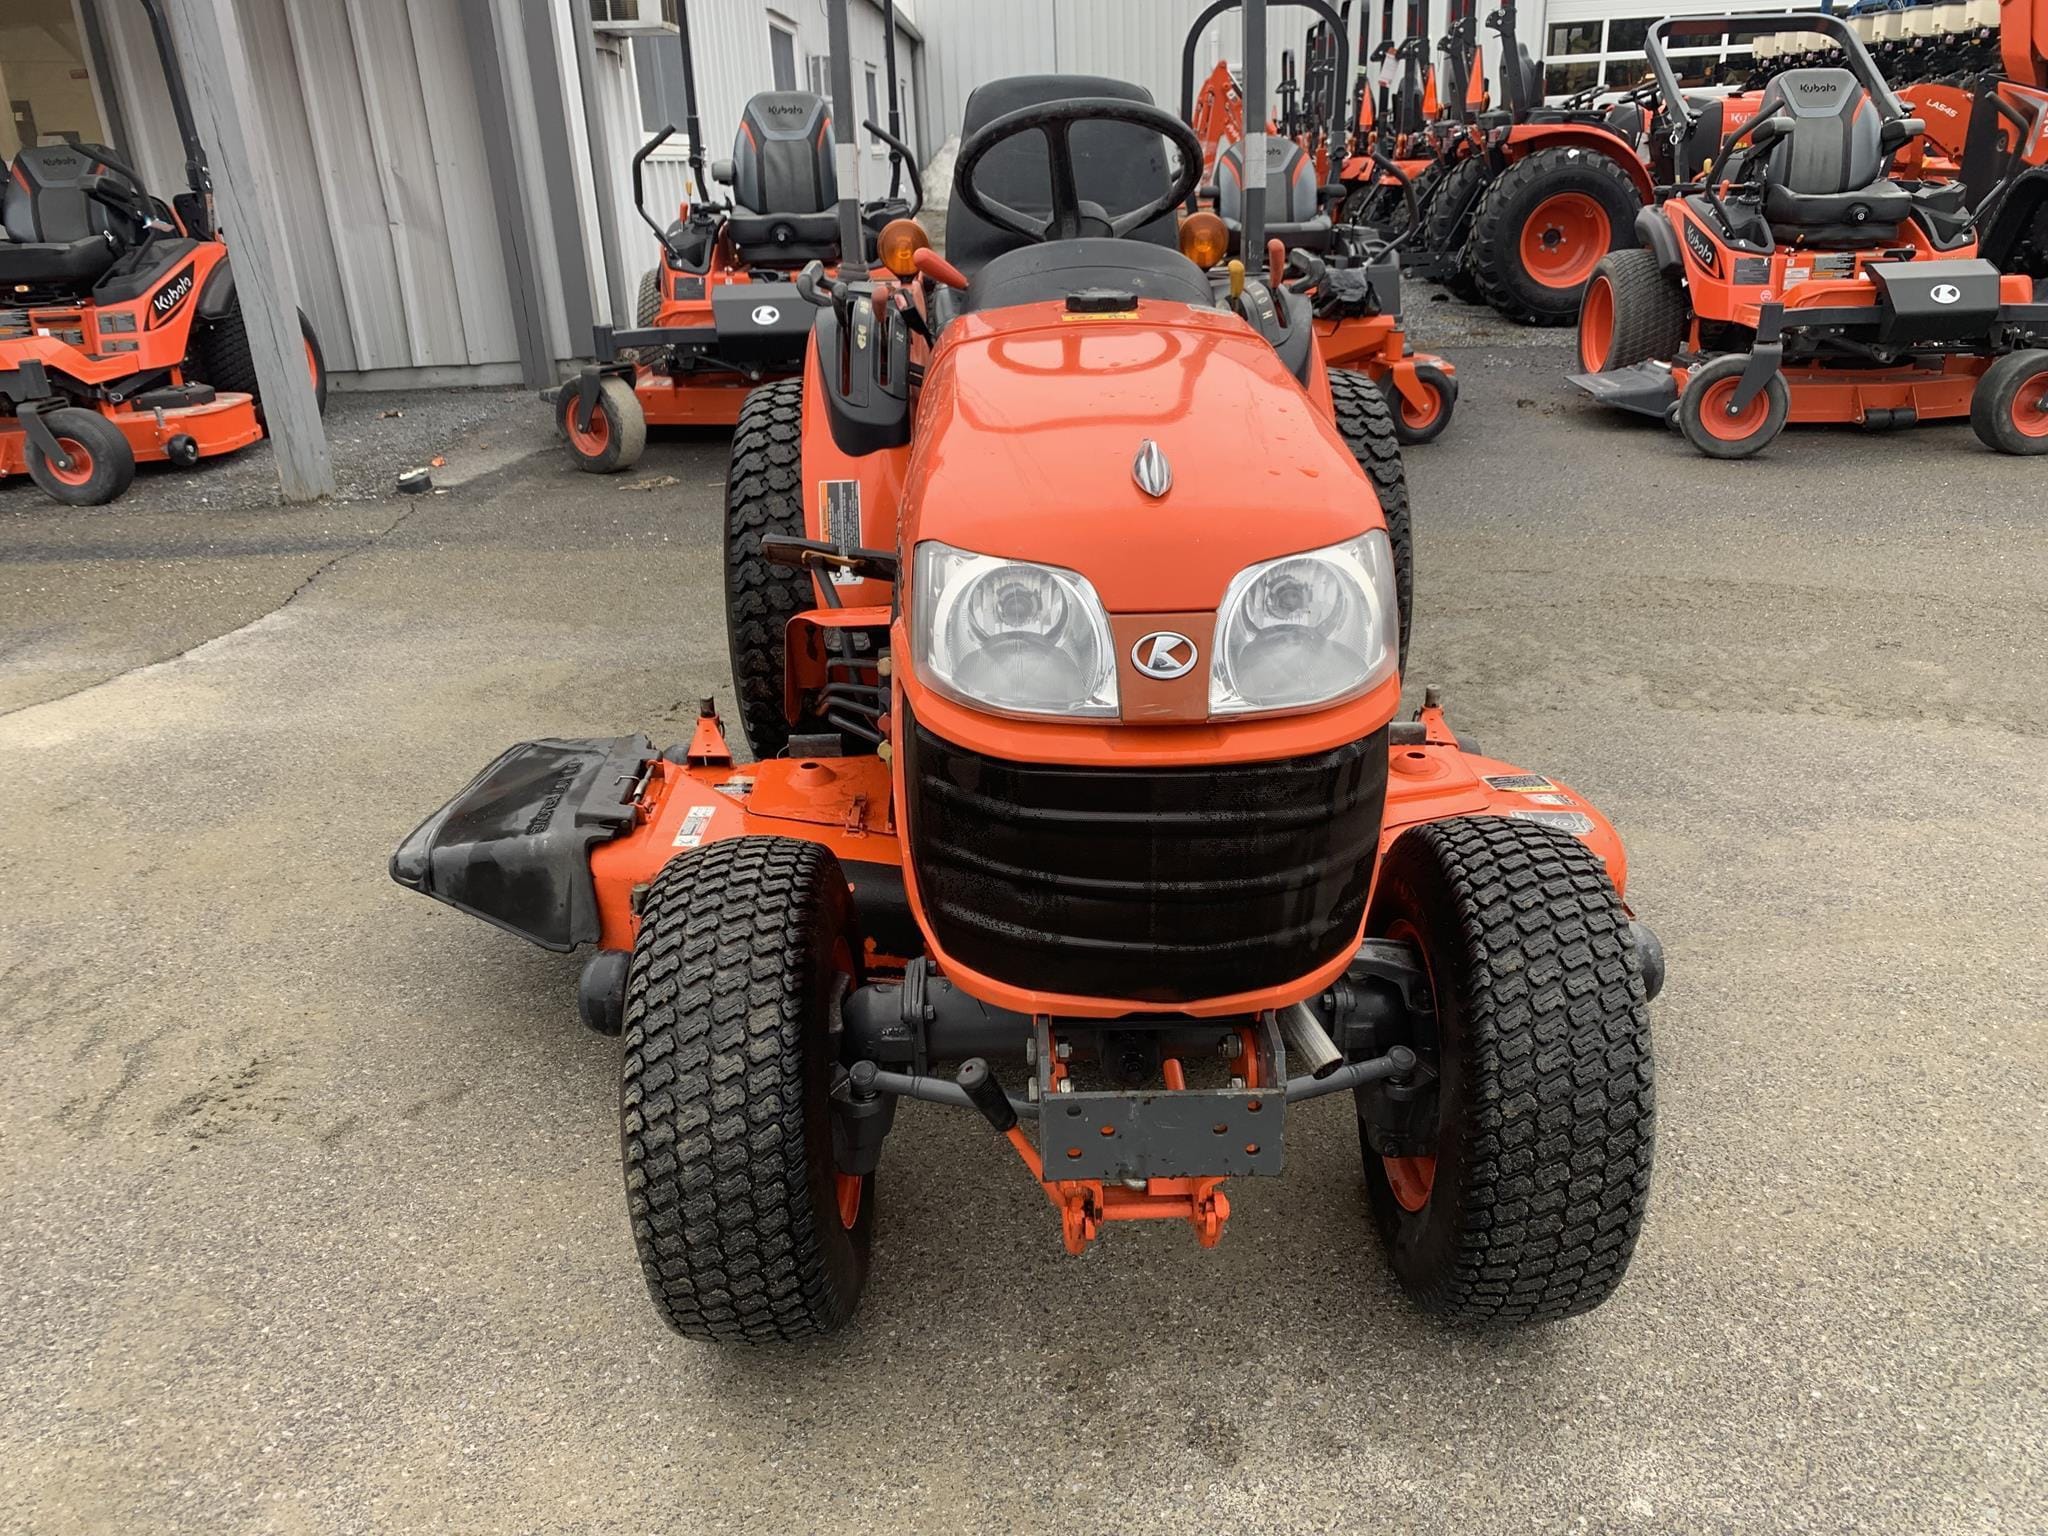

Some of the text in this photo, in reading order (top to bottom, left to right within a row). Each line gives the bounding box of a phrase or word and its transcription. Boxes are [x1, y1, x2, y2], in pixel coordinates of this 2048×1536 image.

[1800, 83, 1837, 93] Kubota
[768, 105, 803, 115] Kubota
[1687, 225, 1713, 264] Kubota
[154, 276, 192, 310] Kubota
